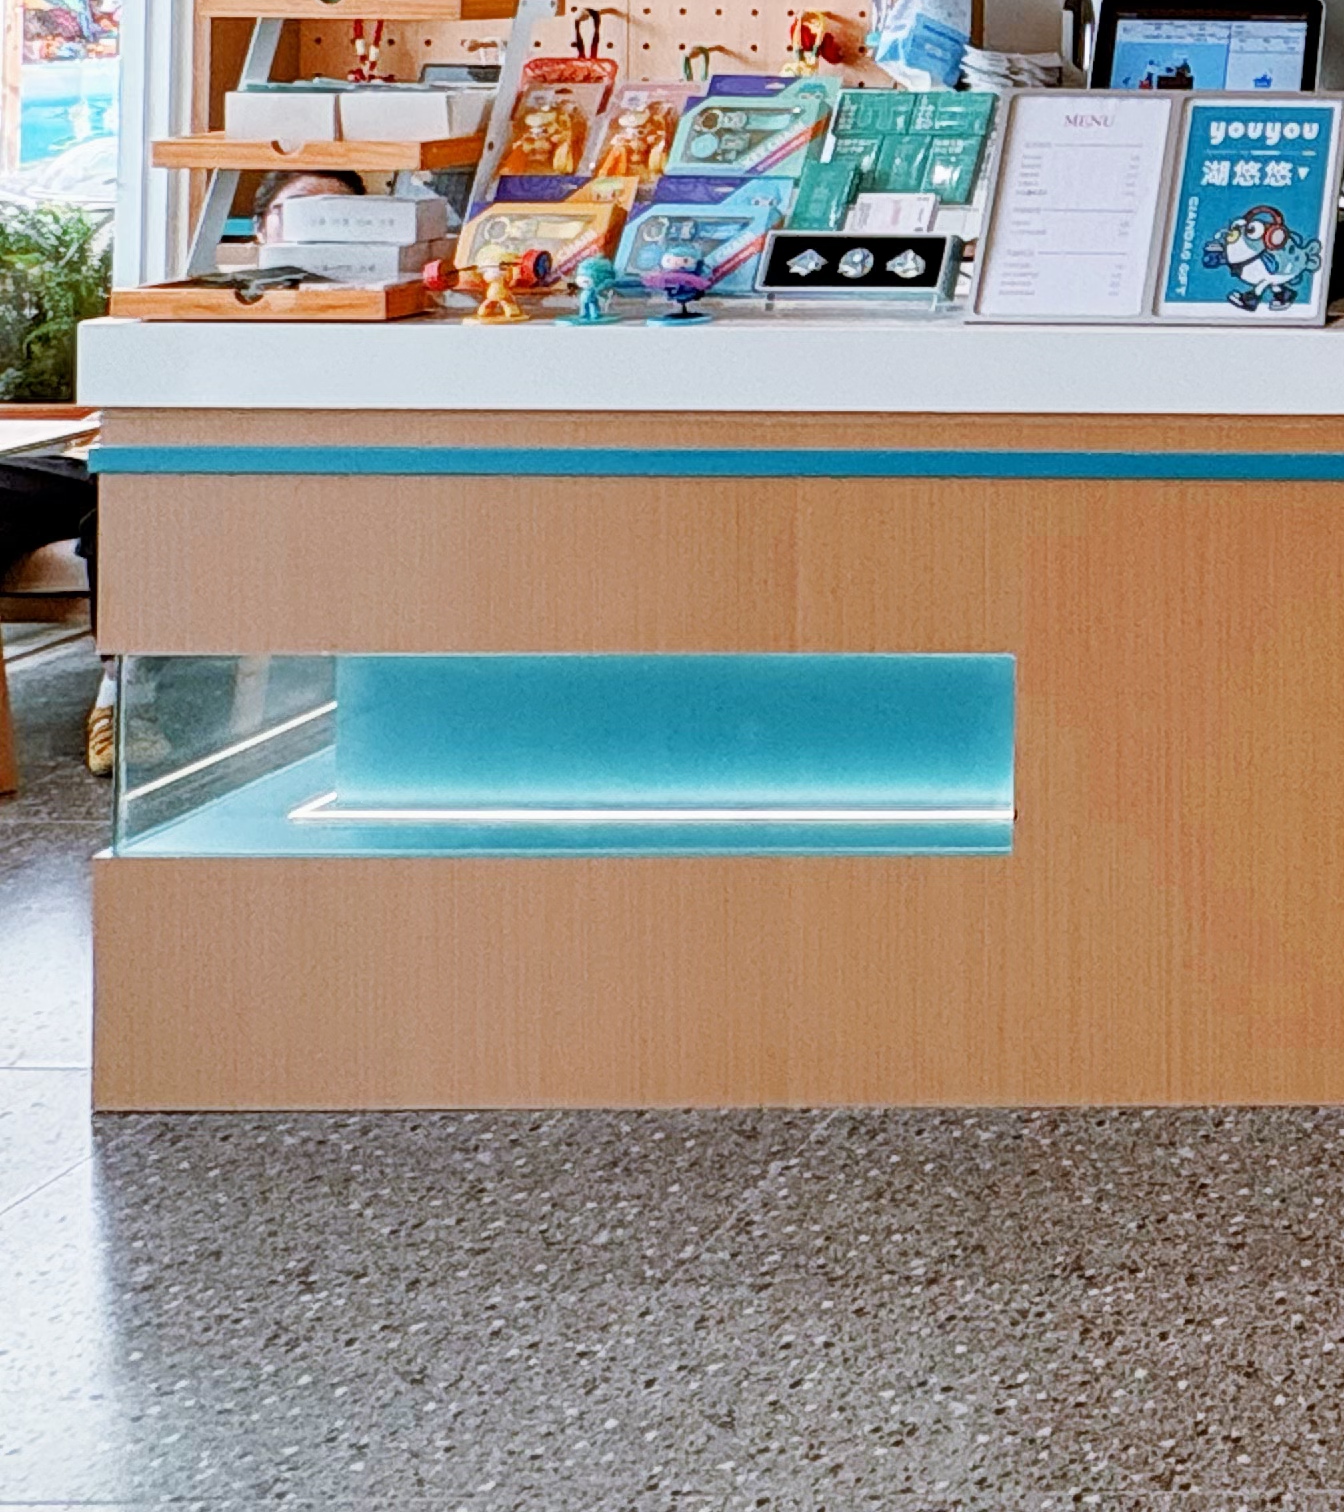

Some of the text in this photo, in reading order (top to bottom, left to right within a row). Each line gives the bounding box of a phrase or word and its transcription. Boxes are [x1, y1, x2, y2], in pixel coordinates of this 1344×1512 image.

[1064, 114, 1116, 128] MENU
[1209, 120, 1320, 146] youyou
[1200, 159, 1294, 187] 湖悠悠
